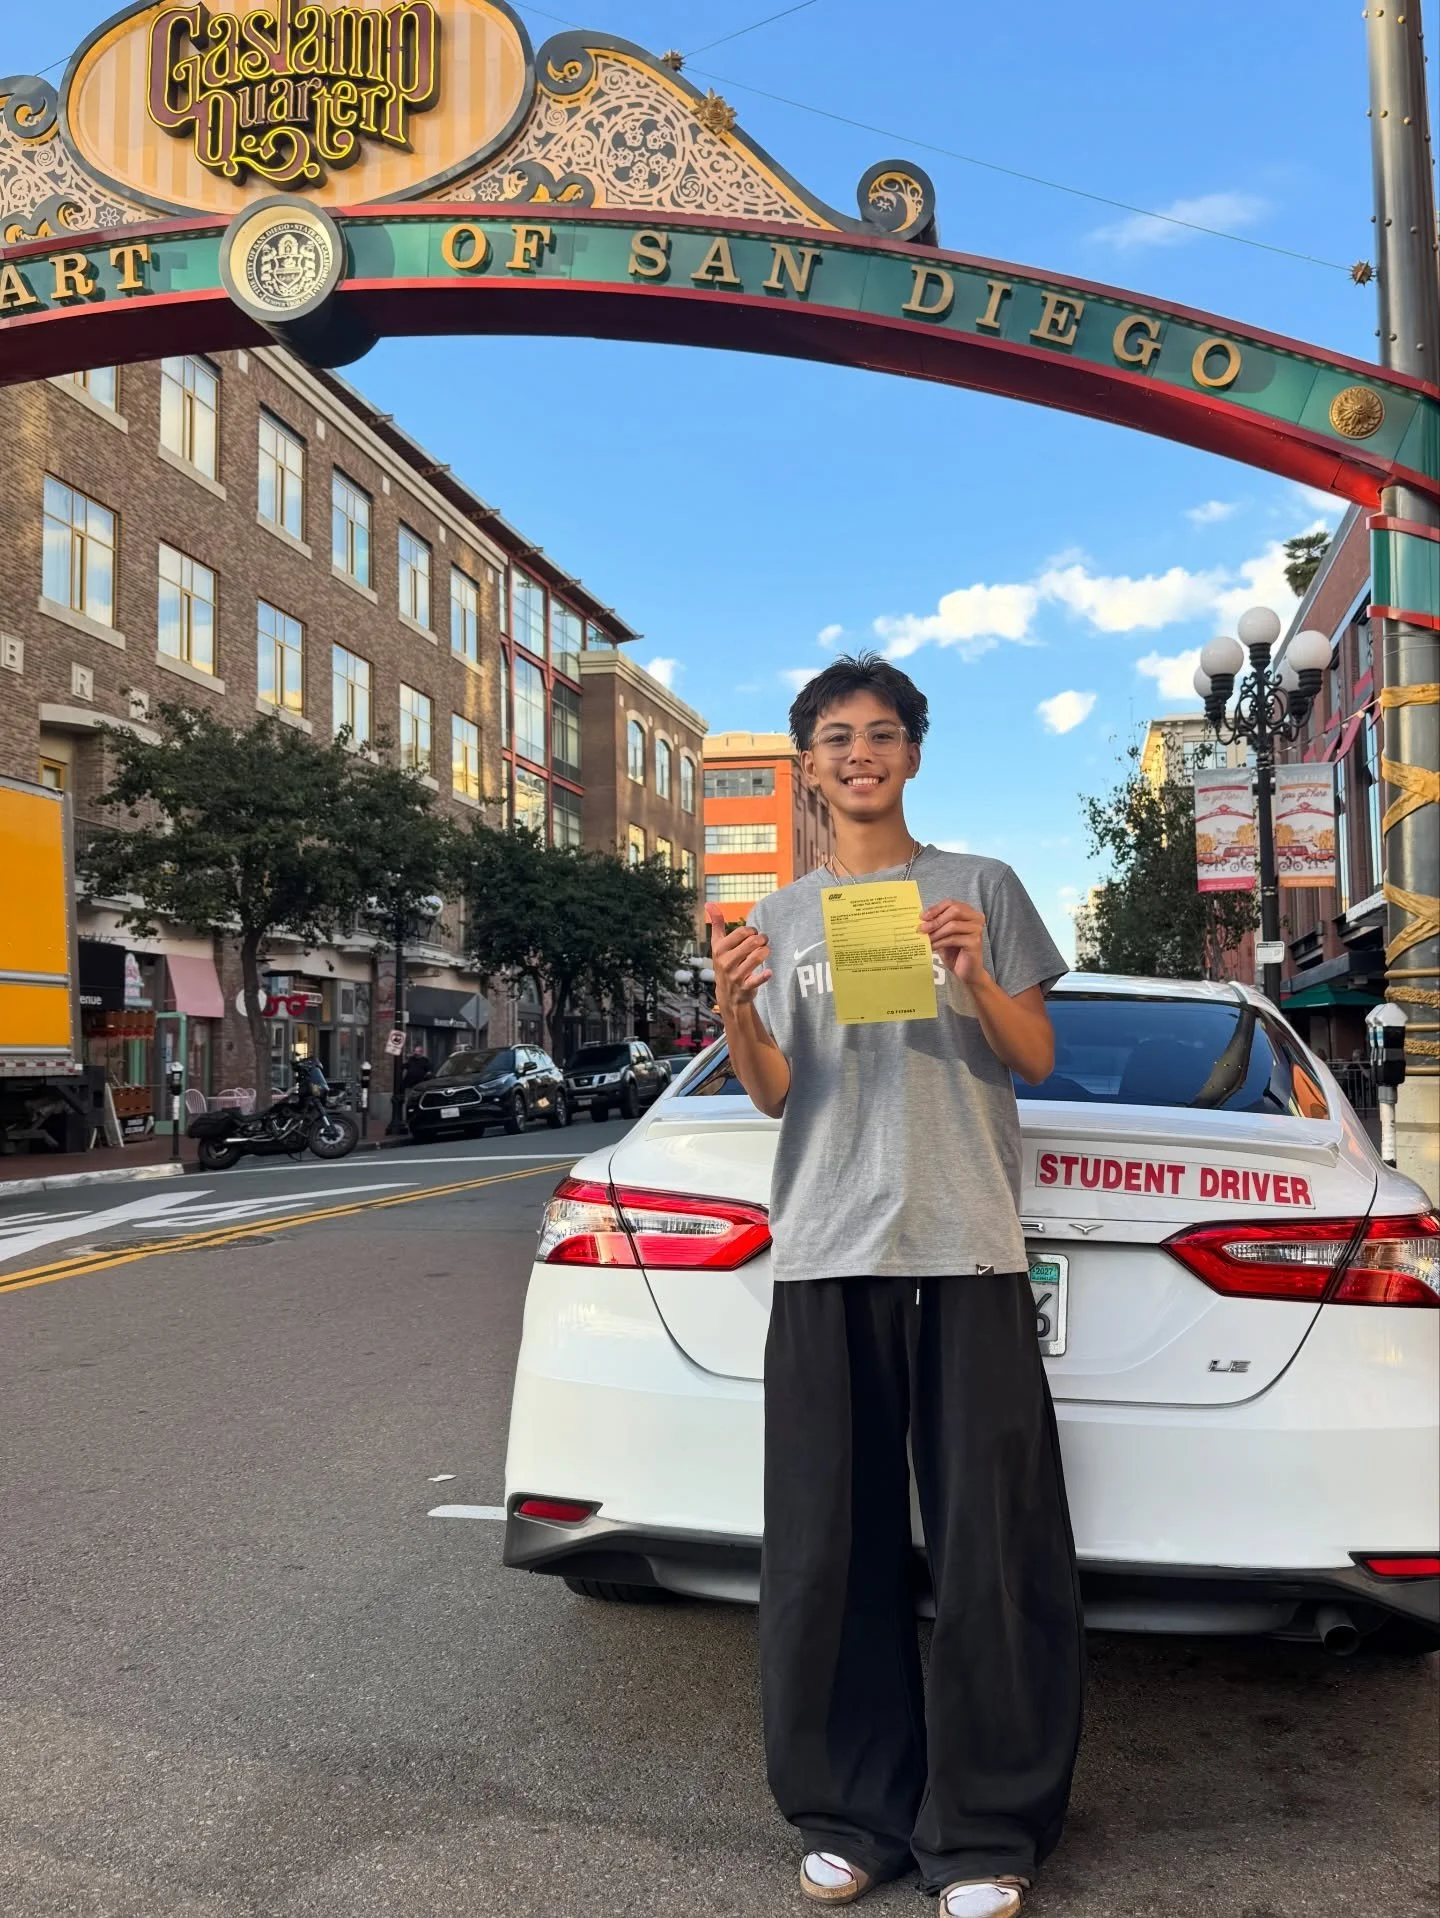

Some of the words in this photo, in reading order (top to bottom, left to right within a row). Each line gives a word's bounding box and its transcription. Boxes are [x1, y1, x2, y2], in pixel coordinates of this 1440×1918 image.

[147, 0, 436, 142] Gaslamp
[194, 77, 390, 181] Quarter
[441, 223, 553, 270] OF
[628, 230, 821, 292] SAN
[902, 264, 1242, 387] DIEGO
[1039, 1153, 1186, 1195] STUDENT
[1200, 1167, 1312, 1206] DRIVER
[1208, 1359, 1251, 1373] LE
